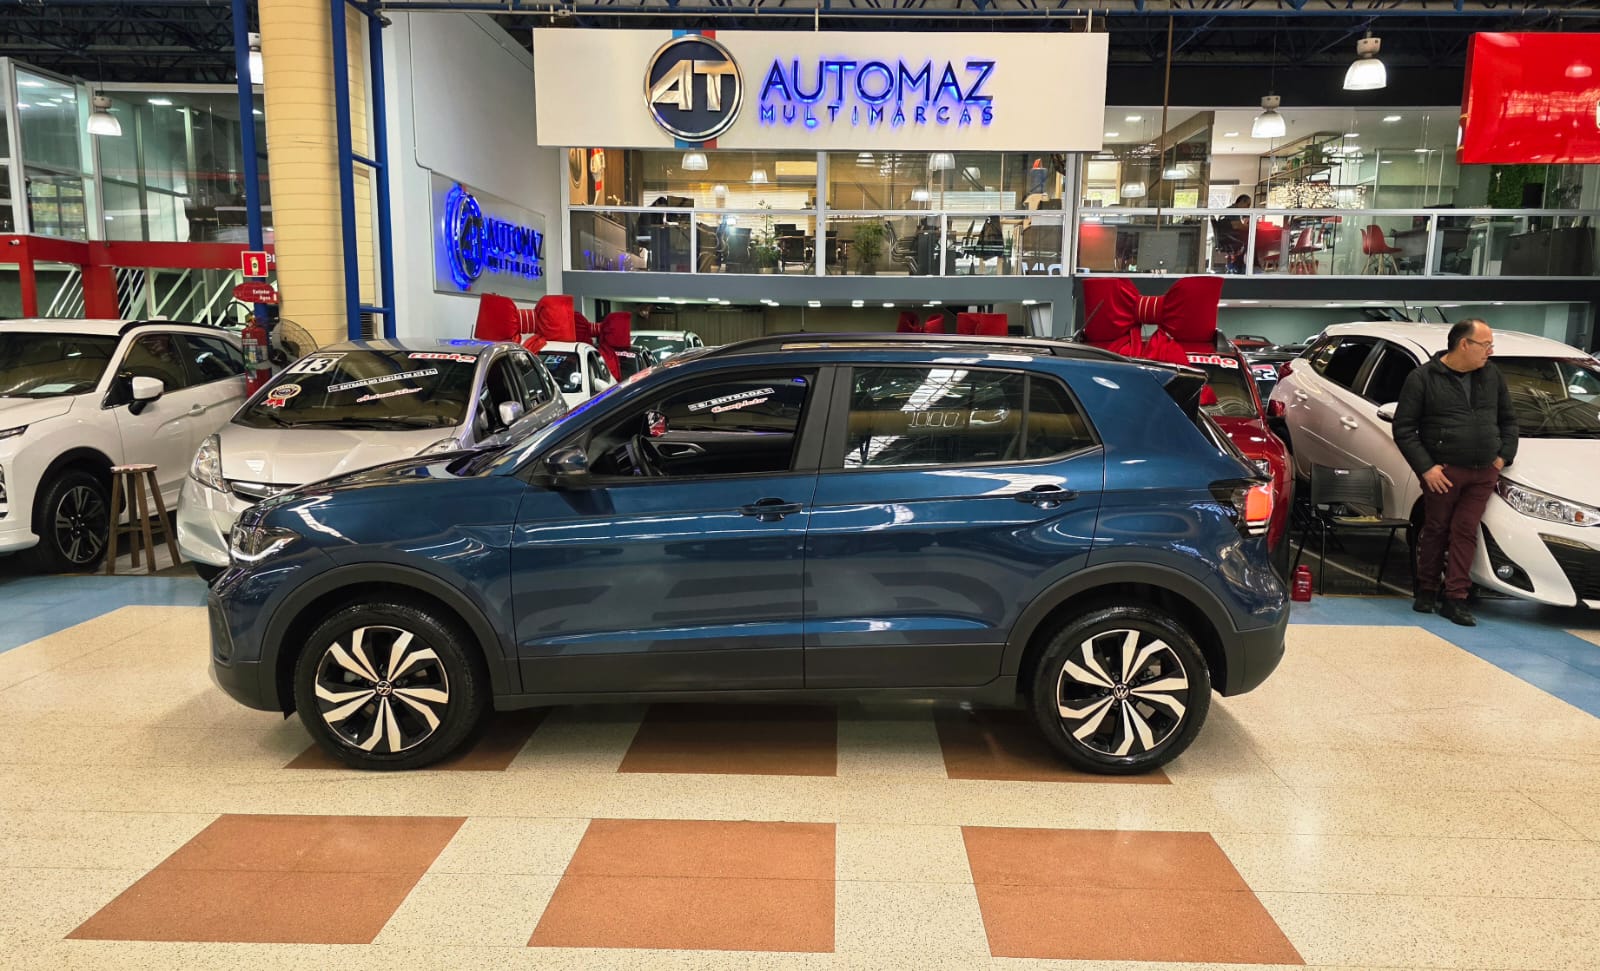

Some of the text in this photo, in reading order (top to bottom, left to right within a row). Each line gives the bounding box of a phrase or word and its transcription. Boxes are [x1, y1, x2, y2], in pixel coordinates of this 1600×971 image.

[760, 59, 996, 102] AUTOMAZ
[760, 105, 994, 123] MULTIMARCAS
[488, 218, 544, 260] AUTOMAZ
[488, 256, 544, 277] MULTIMARCAS
[298, 358, 334, 372] 13
